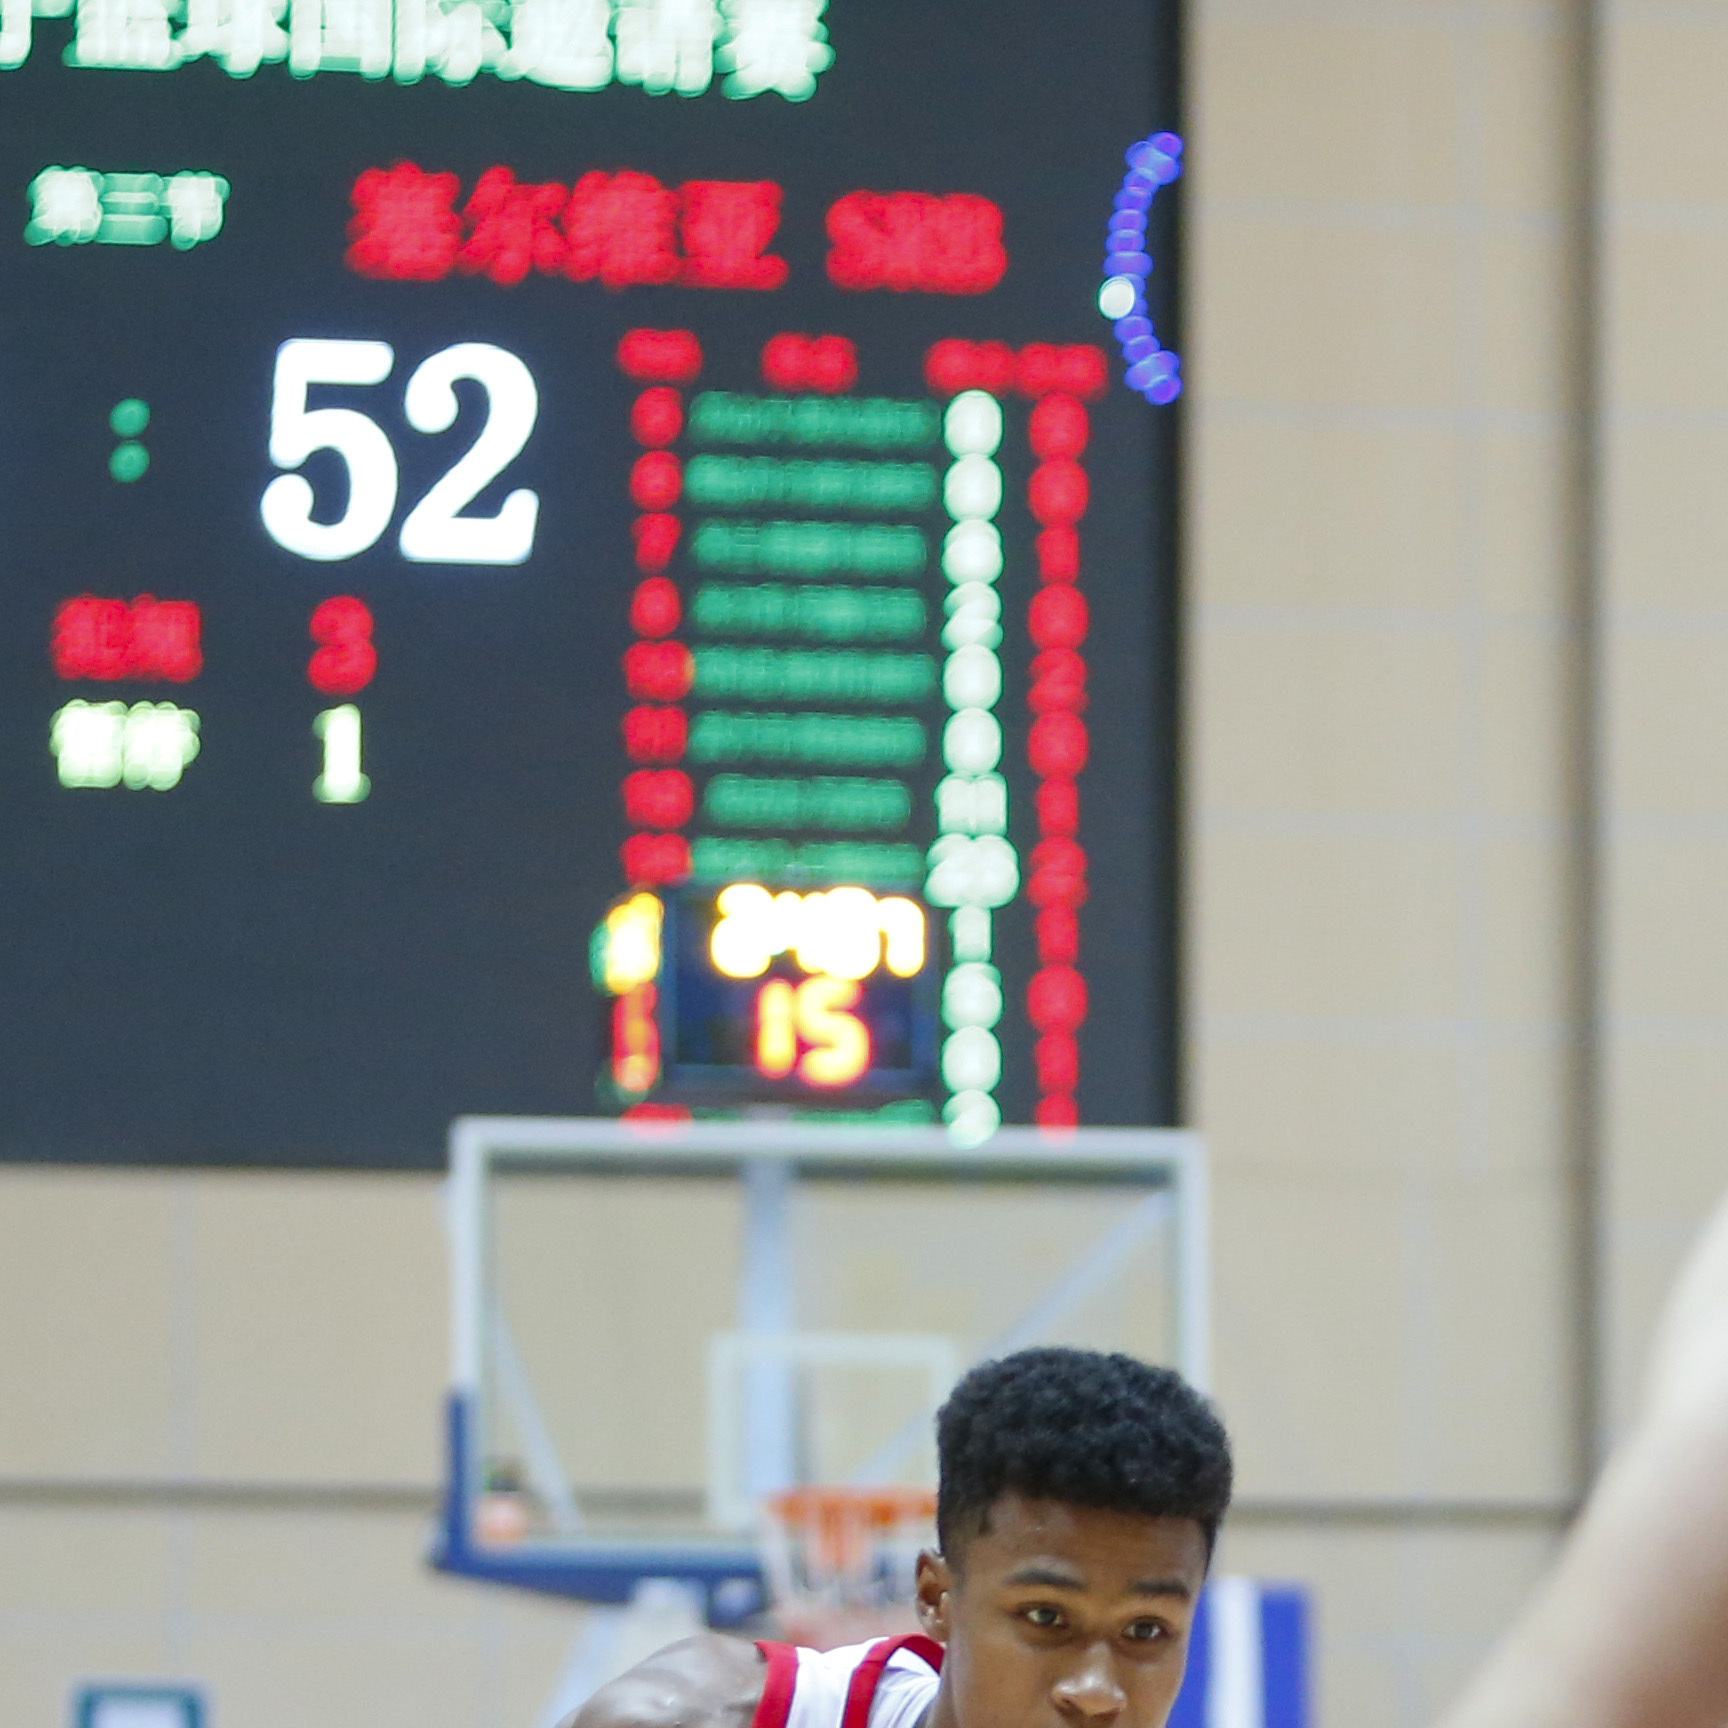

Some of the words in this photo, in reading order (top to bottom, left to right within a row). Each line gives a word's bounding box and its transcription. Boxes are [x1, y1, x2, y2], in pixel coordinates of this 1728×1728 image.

[259, 337, 540, 564] 52
[312, 704, 372, 804] 1
[755, 976, 871, 1087] 15
